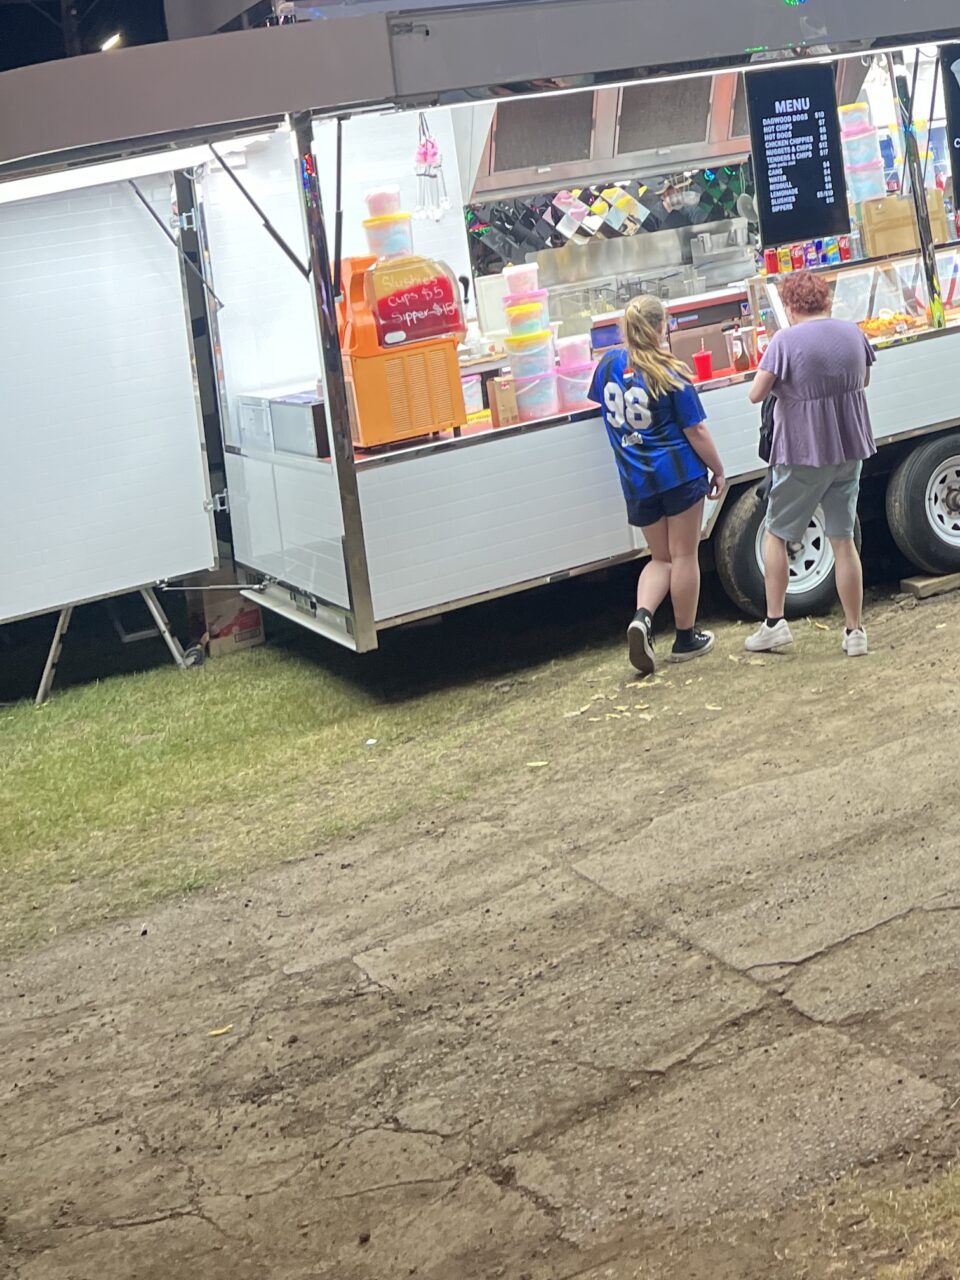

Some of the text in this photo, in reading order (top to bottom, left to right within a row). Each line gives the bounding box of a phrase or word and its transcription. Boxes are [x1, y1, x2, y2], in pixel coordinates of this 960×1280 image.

[775, 97, 810, 114] MENU
[762, 111, 825, 126] DAGWOOD DOGS $10
[763, 125, 775, 133] HOT
[775, 123, 792, 132] CHIPS
[764, 133, 775, 141] HOT
[776, 131, 792, 140] DOGS
[765, 139, 788, 149] CHICKEN
[766, 146, 790, 156] NUGGETS
[796, 143, 812, 151] CHIPS
[819, 141, 828, 149] $12
[766, 153, 791, 164] TENDERS
[796, 150, 812, 159] CHIPS
[819, 149, 828, 157] $17
[768, 160, 830, 176] CANS $4
[768, 168, 831, 183] WATER $4
[769, 181, 792, 191] REDBULL
[770, 187, 798, 198] LEMONADE
[771, 195, 796, 206] SLUSHIES
[771, 203, 793, 213] SIPPERS
[421, 286, 444, 300] $5
[603, 381, 652, 430] 98
